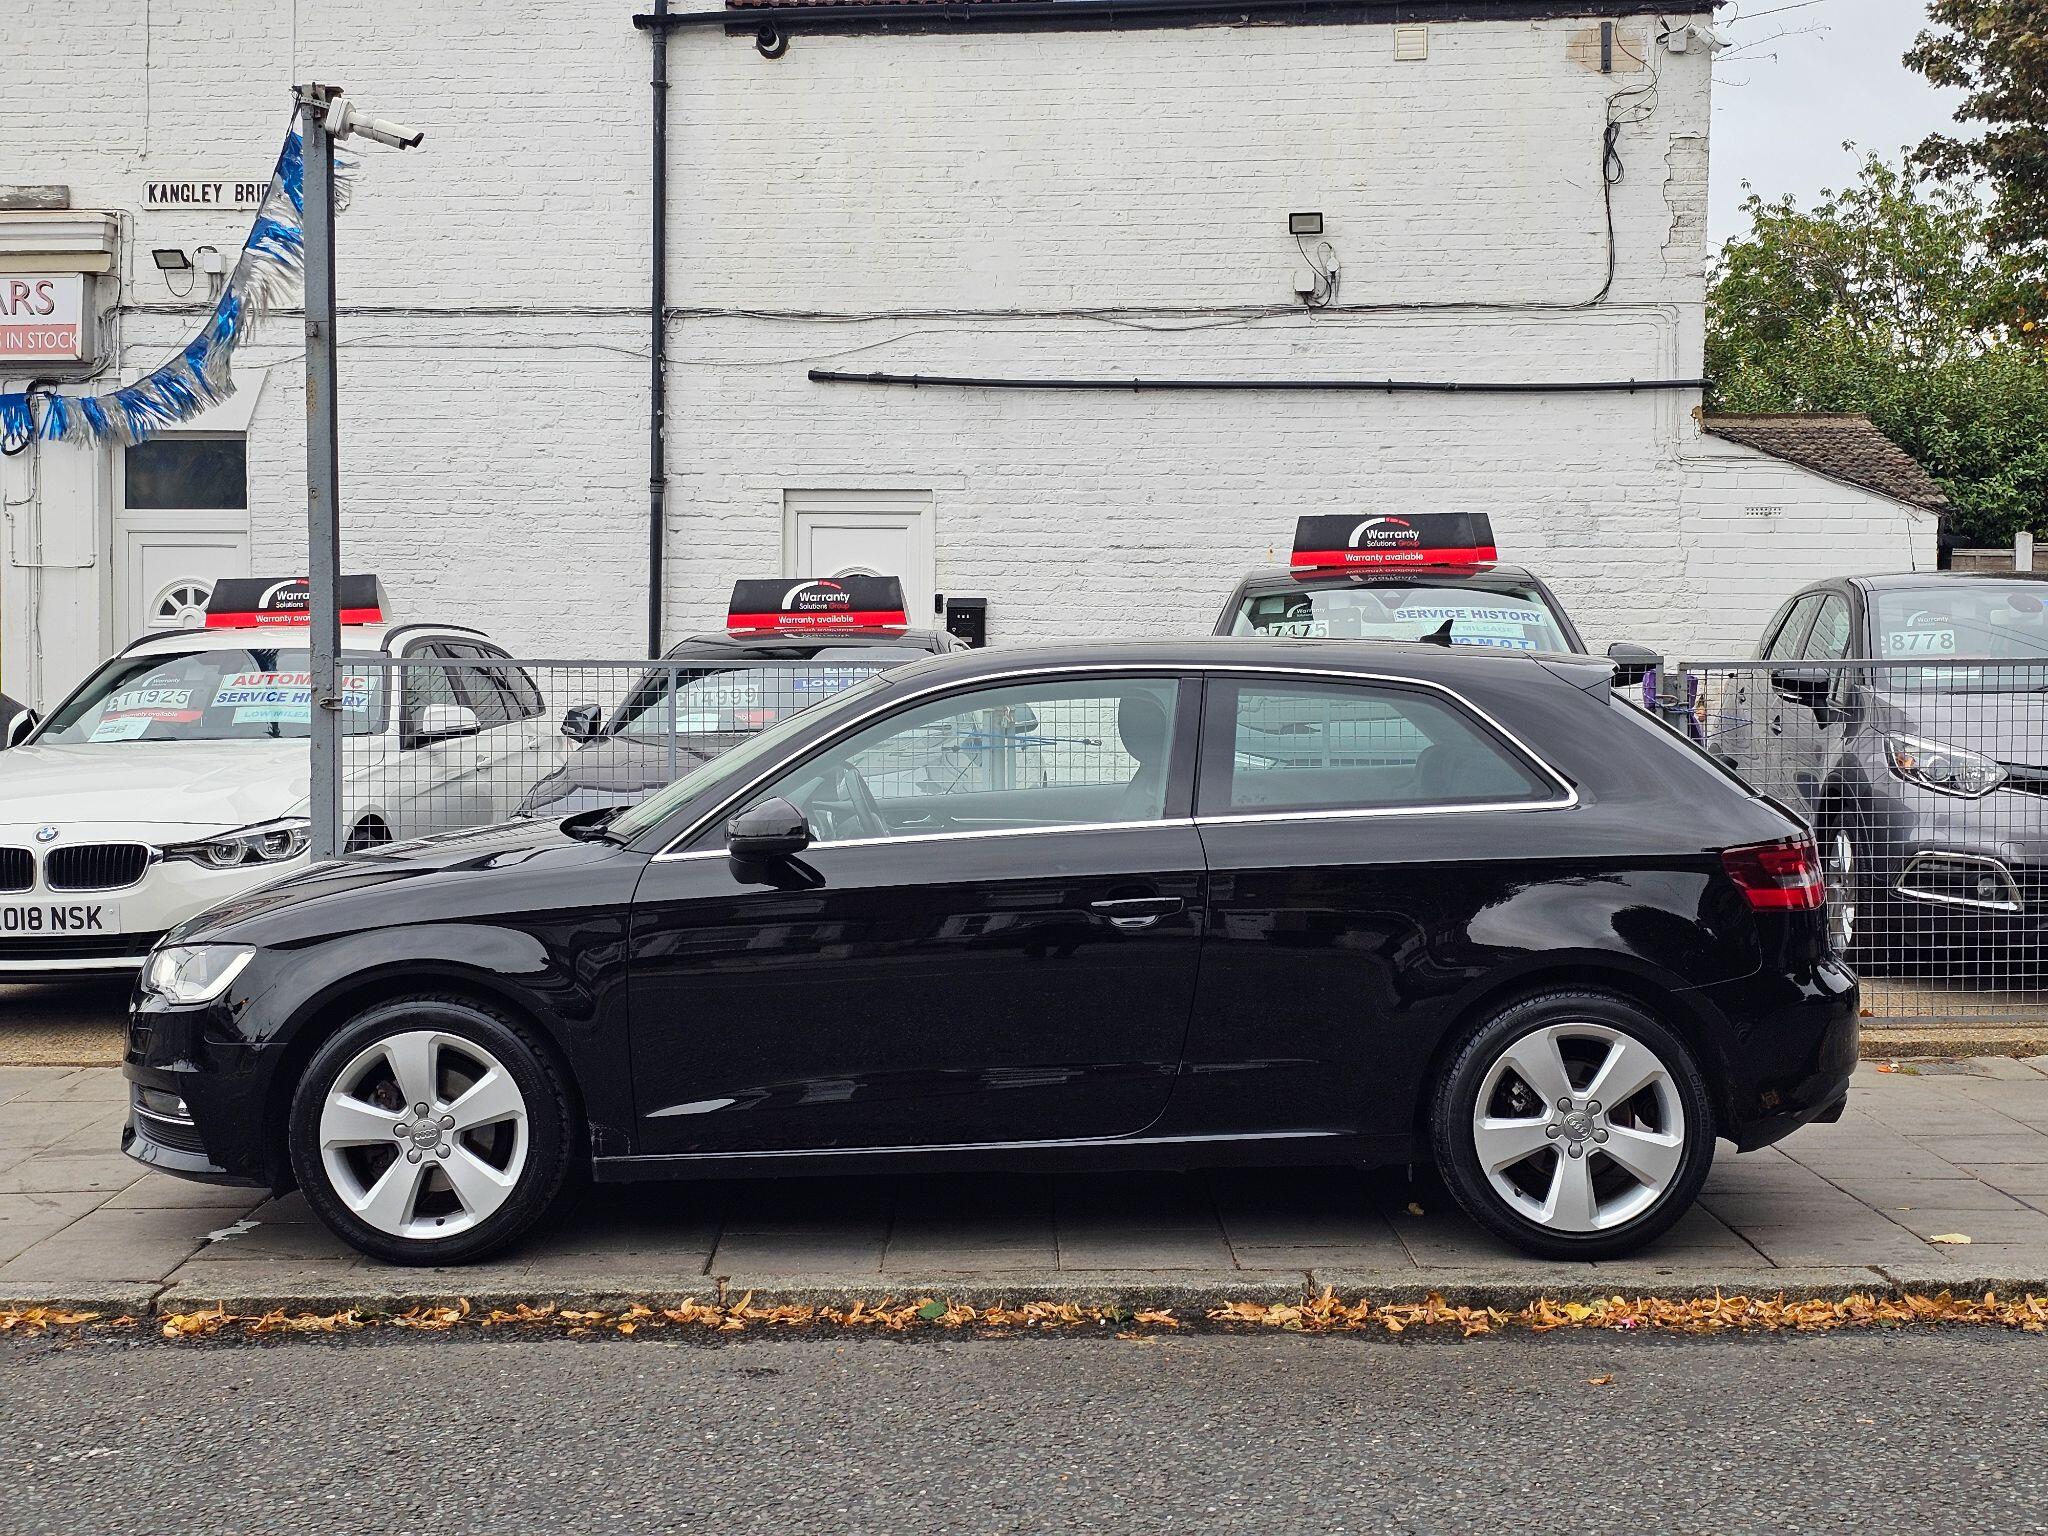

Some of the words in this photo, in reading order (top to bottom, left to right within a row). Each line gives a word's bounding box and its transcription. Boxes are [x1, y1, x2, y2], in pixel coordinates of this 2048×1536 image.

[148, 183, 223, 203] KANGLEY
[6, 332, 23, 349] IN
[27, 331, 77, 349] STOCK
[1366, 529, 1420, 542] Warranty
[1398, 540, 1421, 548] Group
[1344, 553, 1383, 563] Warranty
[1384, 553, 1424, 561] available
[276, 590, 310, 601] Warra
[799, 591, 851, 604] Warranty
[275, 601, 304, 609] Solutions
[798, 602, 828, 610] Solutions
[828, 602, 850, 610] Group
[255, 614, 292, 624] Warranty
[778, 615, 816, 625] Warranty
[816, 614, 854, 624] available
[1396, 609, 1467, 620] SERVICE
[1471, 609, 1542, 623] HISTORY
[1917, 616, 1949, 624] Warranty
[231, 674, 365, 690] AUTOMIC
[802, 680, 839, 689] LOW
[217, 692, 288, 703] SERVICE
[291, 692, 366, 707] HIRY
[0, 907, 43, 931] O18
[50, 905, 103, 931] NSK
